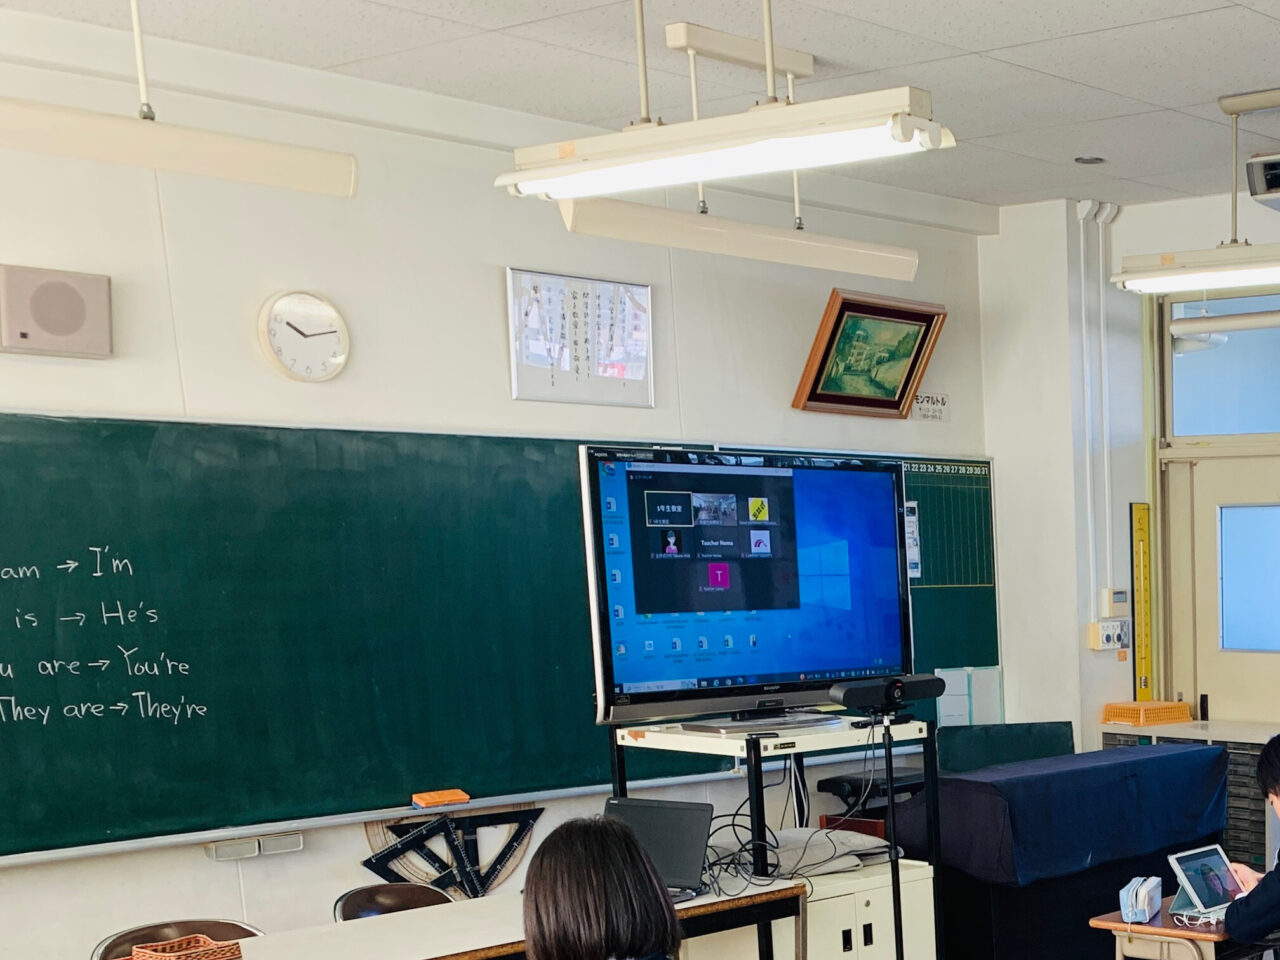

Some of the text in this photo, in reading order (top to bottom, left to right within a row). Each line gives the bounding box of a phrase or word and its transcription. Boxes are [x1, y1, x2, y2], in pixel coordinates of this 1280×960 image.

[915, 394, 947, 406] モンマルトル
[0, 545, 133, 579] am I'm
[716, 570, 722, 582] T
[15, 600, 159, 628] is He's
[38, 659, 80, 675] are
[117, 644, 190, 676] You're
[63, 702, 105, 717] are
[132, 691, 208, 725] They're
